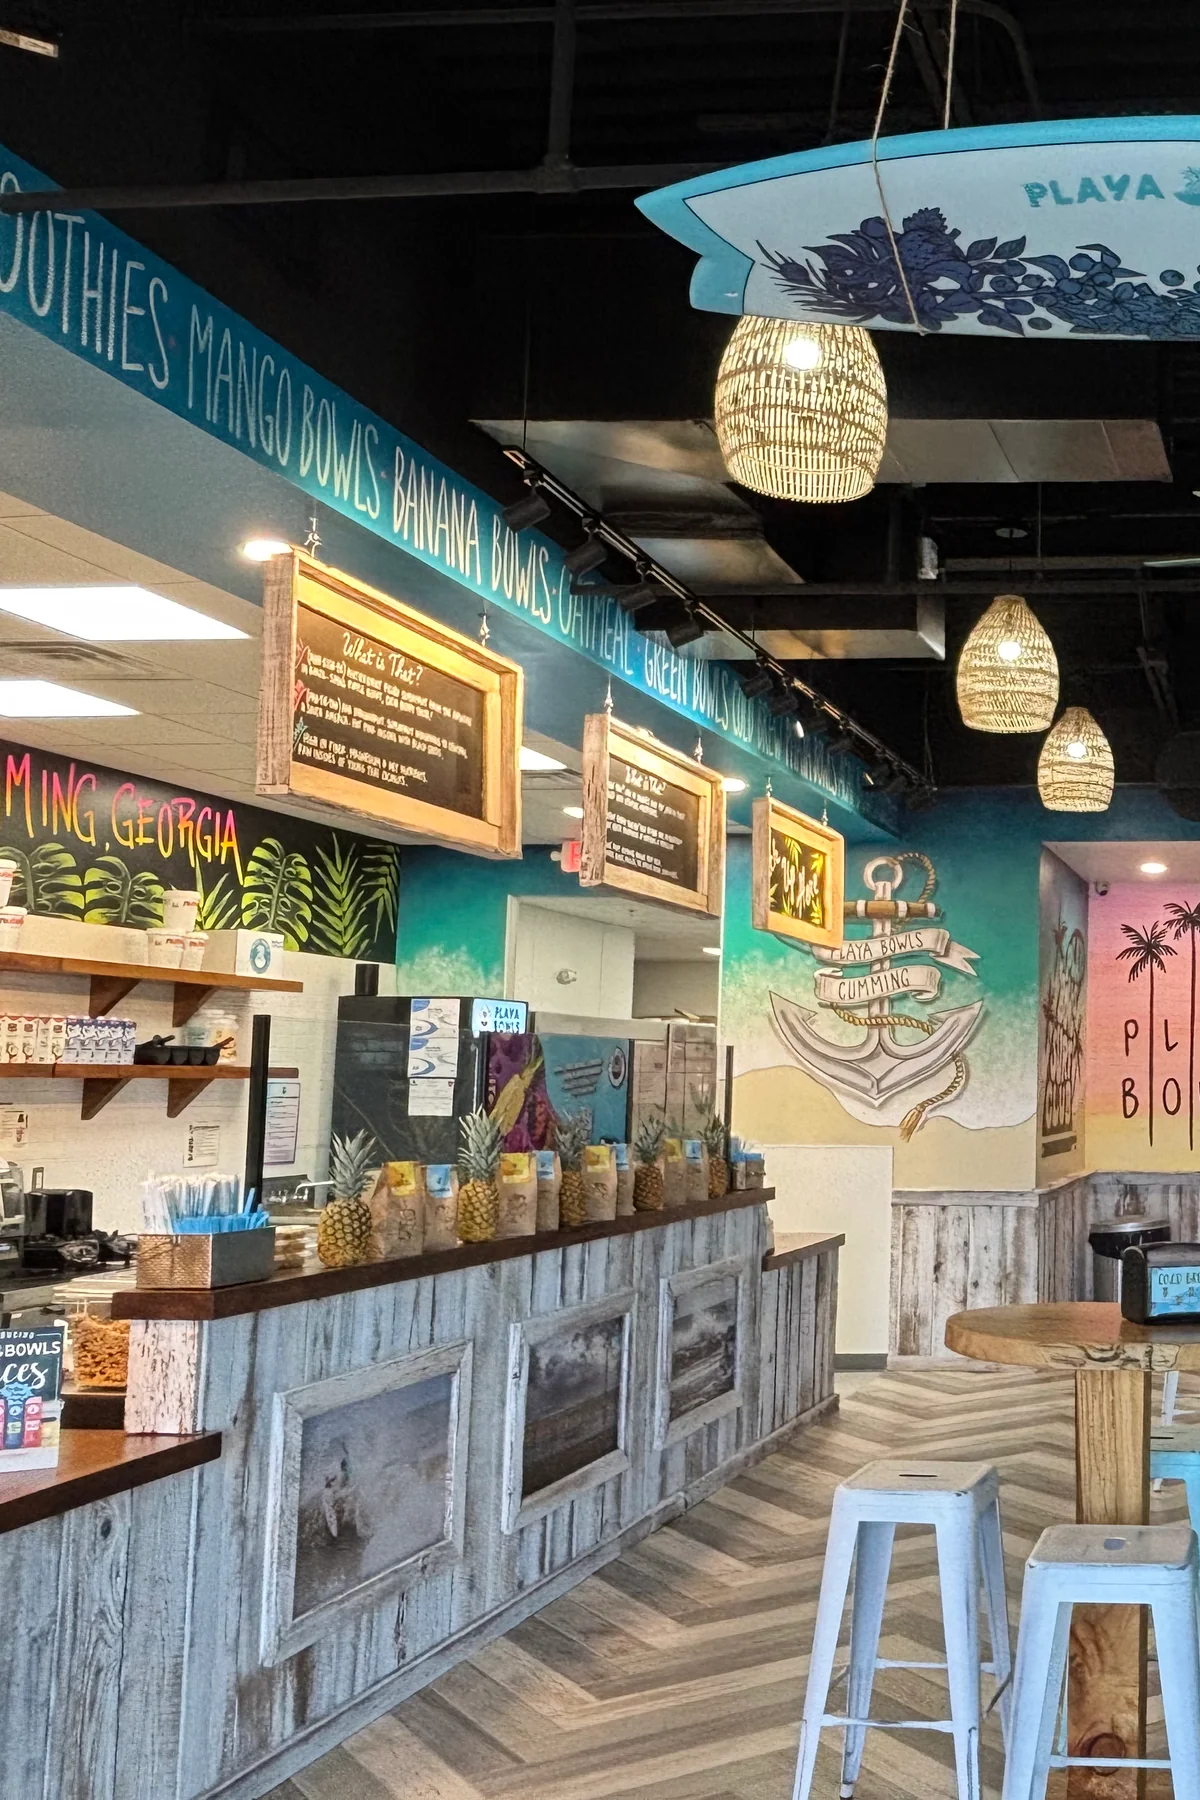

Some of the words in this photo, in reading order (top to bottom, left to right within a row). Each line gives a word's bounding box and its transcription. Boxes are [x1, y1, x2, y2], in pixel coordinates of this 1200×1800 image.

[1020, 173, 1165, 208] PLAYA
[188, 304, 293, 466] MANGO
[300, 384, 380, 520] BOWLS
[393, 446, 482, 585] BANANA
[492, 517, 551, 625] BOWLS
[644, 638, 688, 706] GREEN
[693, 656, 729, 731] BOWLS
[343, 631, 376, 666] What
[112, 782, 244, 887] GEORGIA
[881, 932, 923, 955] BOWLS
[838, 968, 910, 1000] CUMMING
